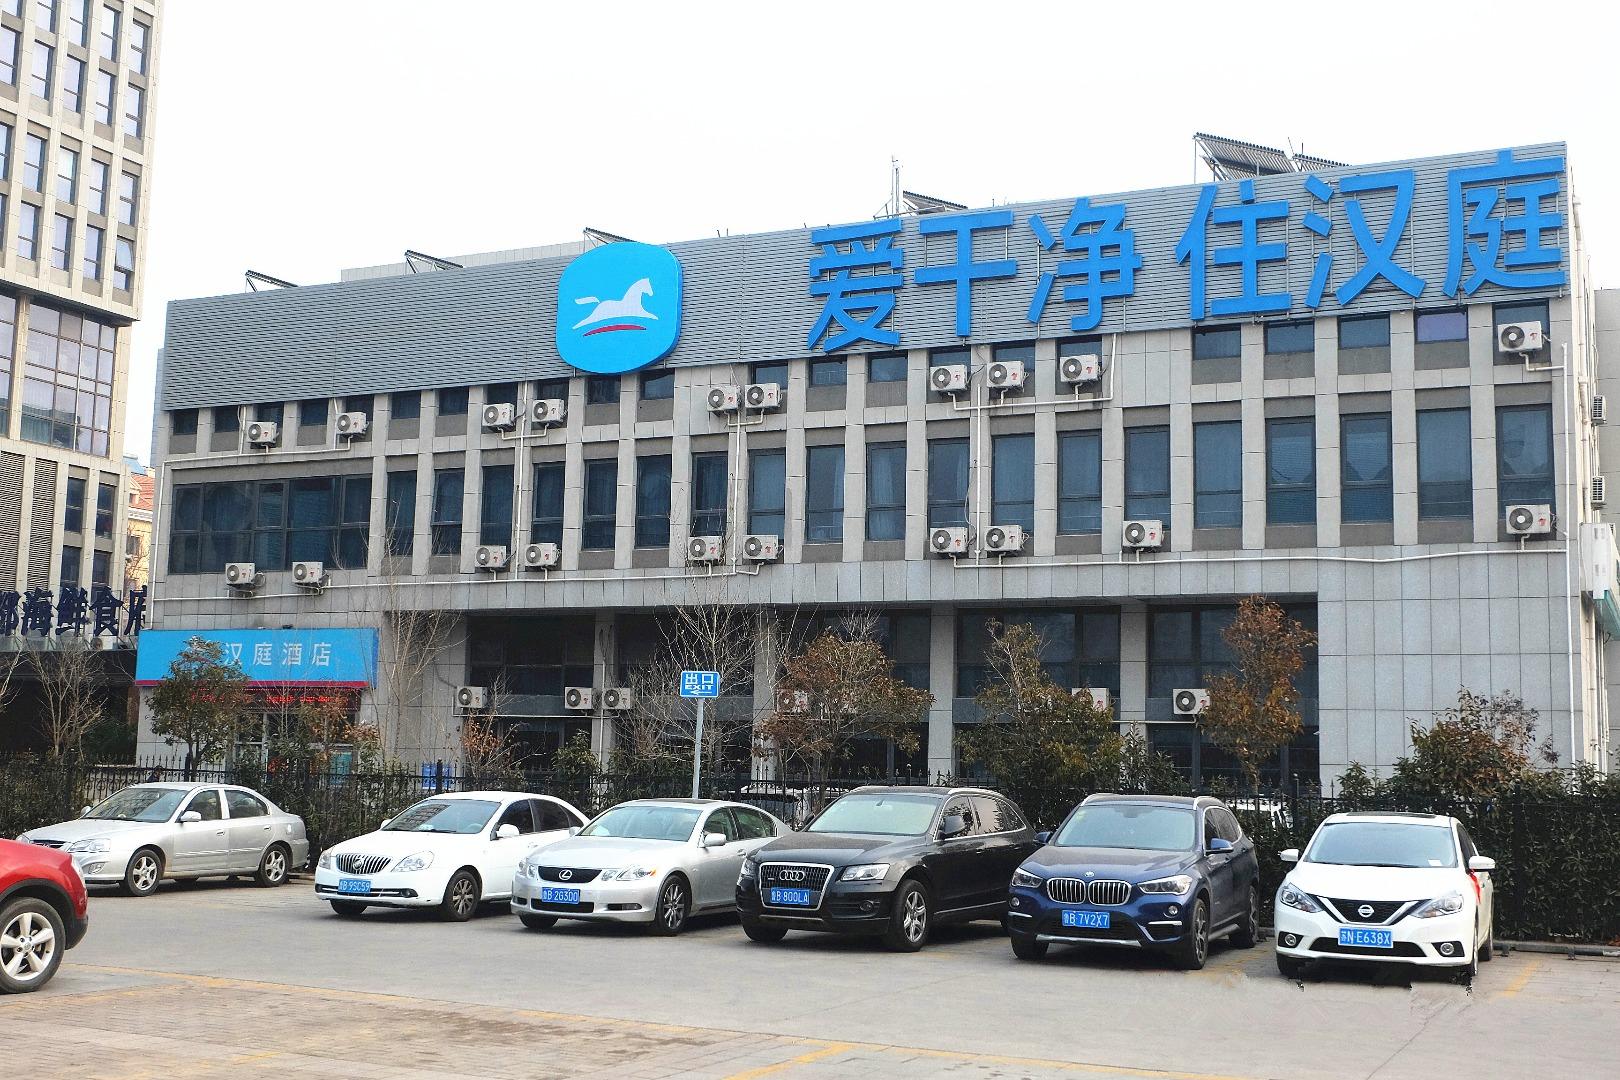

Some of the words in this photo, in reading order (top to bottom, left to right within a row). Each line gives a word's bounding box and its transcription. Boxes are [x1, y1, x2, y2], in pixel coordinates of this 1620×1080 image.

[807, 197, 1143, 354] 爱干净
[1175, 149, 1567, 320] 住汉庭
[223, 641, 332, 667] 汉庭酒店
[685, 672, 714, 685] 出口
